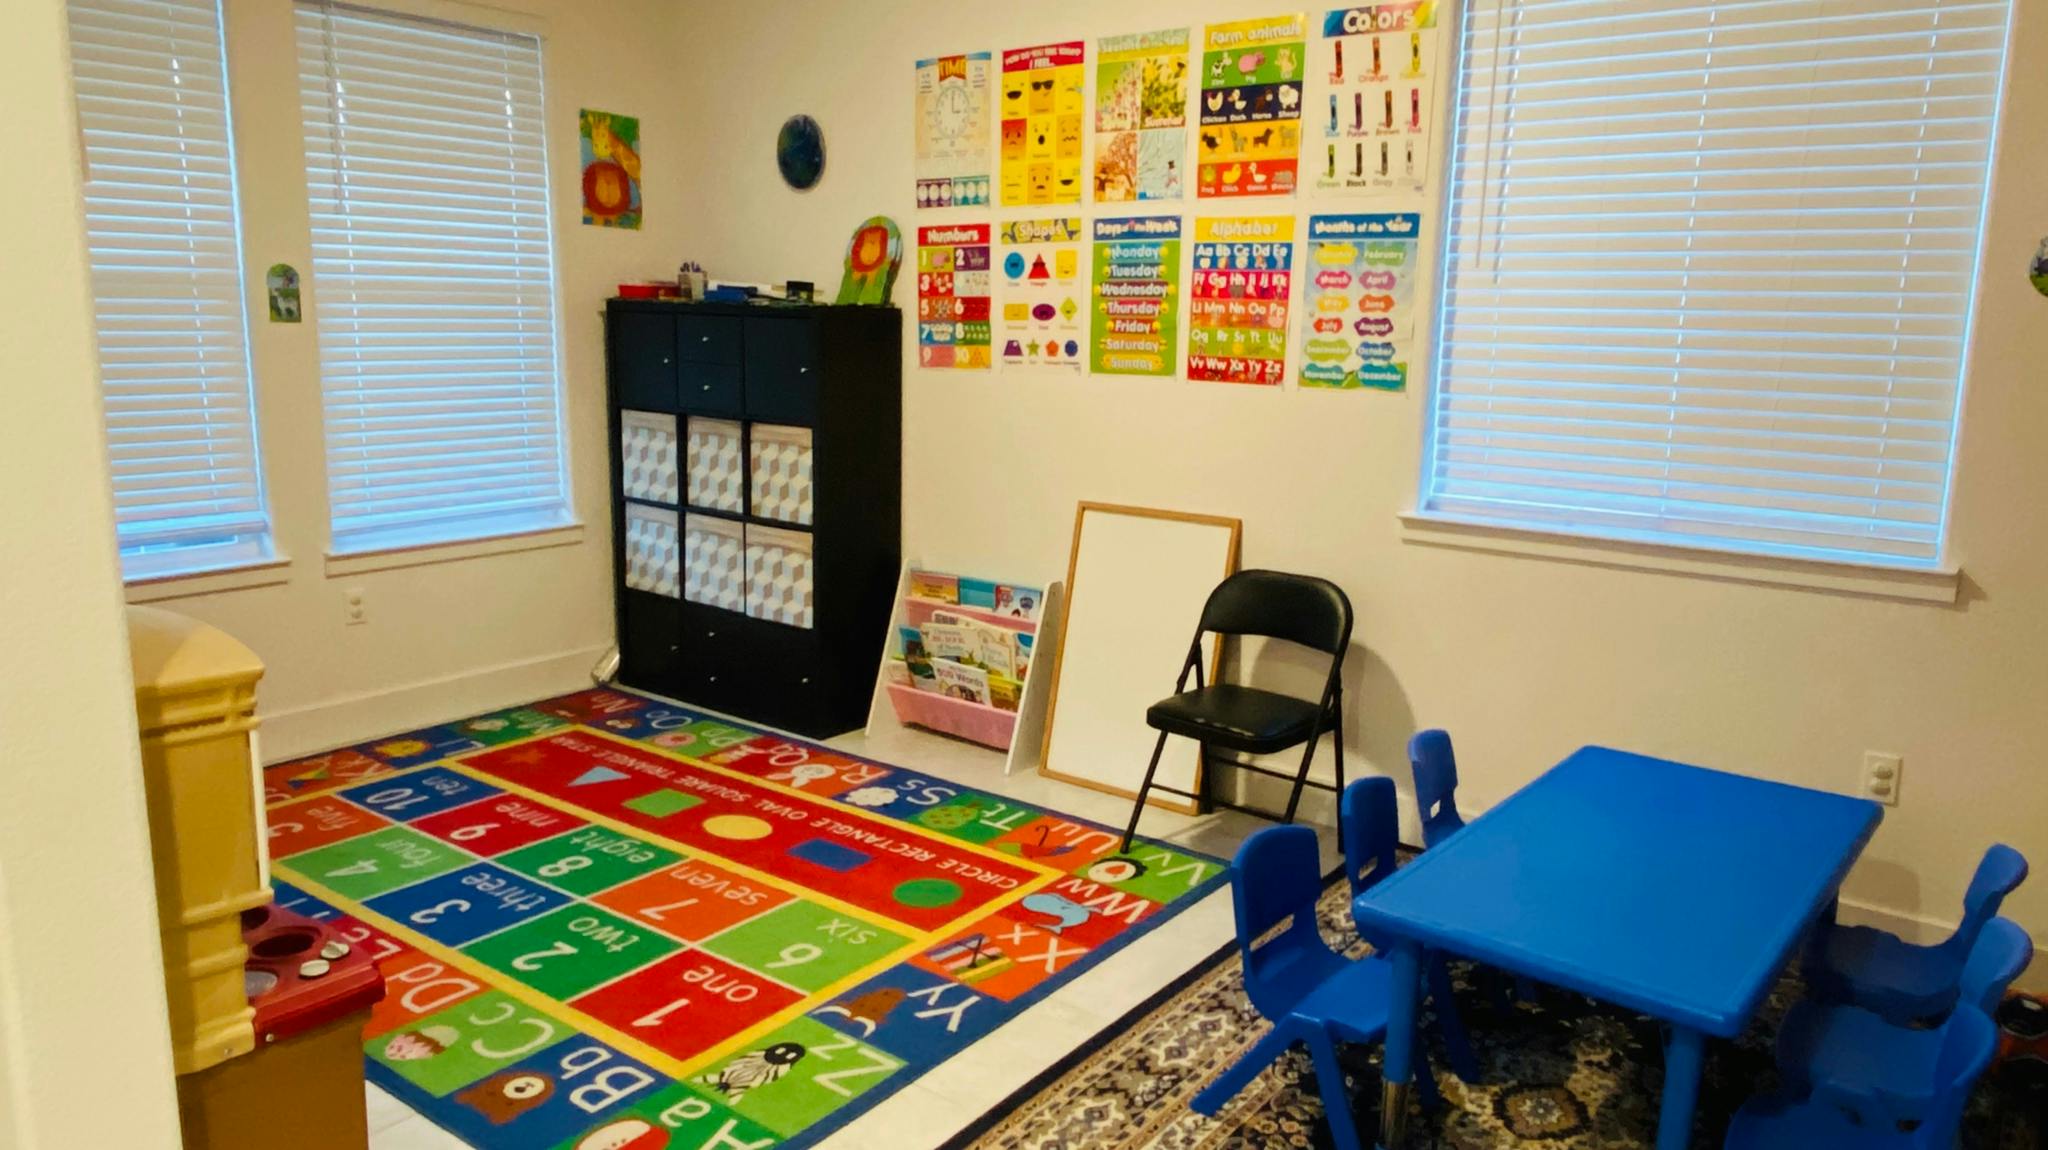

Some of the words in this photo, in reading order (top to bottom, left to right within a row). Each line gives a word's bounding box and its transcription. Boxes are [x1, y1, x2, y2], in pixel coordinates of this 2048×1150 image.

[1343, 7, 1413, 33] Colors
[1210, 29, 1243, 47] Farm
[928, 227, 979, 243] Numbers
[1210, 222, 1277, 240] Alphabet
[956, 248, 965, 266] 2
[1112, 244, 1160, 261] Monday
[1195, 245, 1213, 257] Aa
[1215, 245, 1231, 257] Bb
[1234, 245, 1250, 257] Cc
[1252, 244, 1270, 257] Dd
[1273, 244, 1288, 257] Ee
[920, 274, 930, 292] 3
[1111, 264, 1159, 280] Tuesday
[1208, 272, 1227, 289] Gg
[1230, 273, 1246, 287] Hh
[1272, 274, 1288, 288] Kk
[1102, 282, 1168, 298] Wednesday
[955, 298, 964, 314] 6
[1107, 302, 1160, 317] Thursday
[1204, 302, 1225, 314] Mm
[1229, 302, 1245, 314] Nn
[1248, 303, 1266, 315] Oo
[1270, 303, 1285, 318] Pp
[921, 323, 931, 339] 7
[956, 322, 964, 339] 8
[1115, 320, 1151, 335] Friday
[1191, 329, 1208, 344] Qq
[1107, 338, 1160, 353] Saturday
[1190, 358, 1205, 369] Vv
[1205, 358, 1226, 370] Ww
[1229, 359, 1245, 372] Xx
[1248, 360, 1262, 375] Yy
[1265, 360, 1281, 374] Zz
[646, 709, 693, 729] Oo
[422, 773, 468, 795] ten
[673, 774, 752, 802] SQUARE
[900, 778, 957, 806] Ss
[366, 788, 431, 811] 10
[754, 799, 808, 820] OVAL
[495, 800, 559, 828] nine
[979, 803, 1027, 832] Tt
[567, 830, 656, 865] eight
[810, 816, 936, 862] RECTANGLE
[1051, 822, 1124, 856] Uu
[375, 838, 442, 870] four
[537, 855, 595, 878] 8
[324, 858, 380, 878] 4
[937, 858, 1019, 889] CIRCLE
[1144, 850, 1208, 887] Vv
[461, 871, 548, 914] three
[670, 865, 770, 907] seven
[410, 898, 472, 925] 3
[639, 897, 699, 921] 7
[1057, 877, 1151, 925] Ww
[567, 915, 641, 954] two
[816, 917, 879, 947] six
[511, 940, 580, 971] 2
[765, 942, 823, 969] 6
[997, 924, 1091, 975] Xx
[385, 962, 481, 1013] Dd
[682, 963, 759, 1004] one
[631, 998, 692, 1028] 1
[907, 982, 982, 1033] Yy
[468, 1002, 555, 1059] Cc
[809, 1033, 904, 1098] Zz
[559, 1046, 657, 1114] Bb
